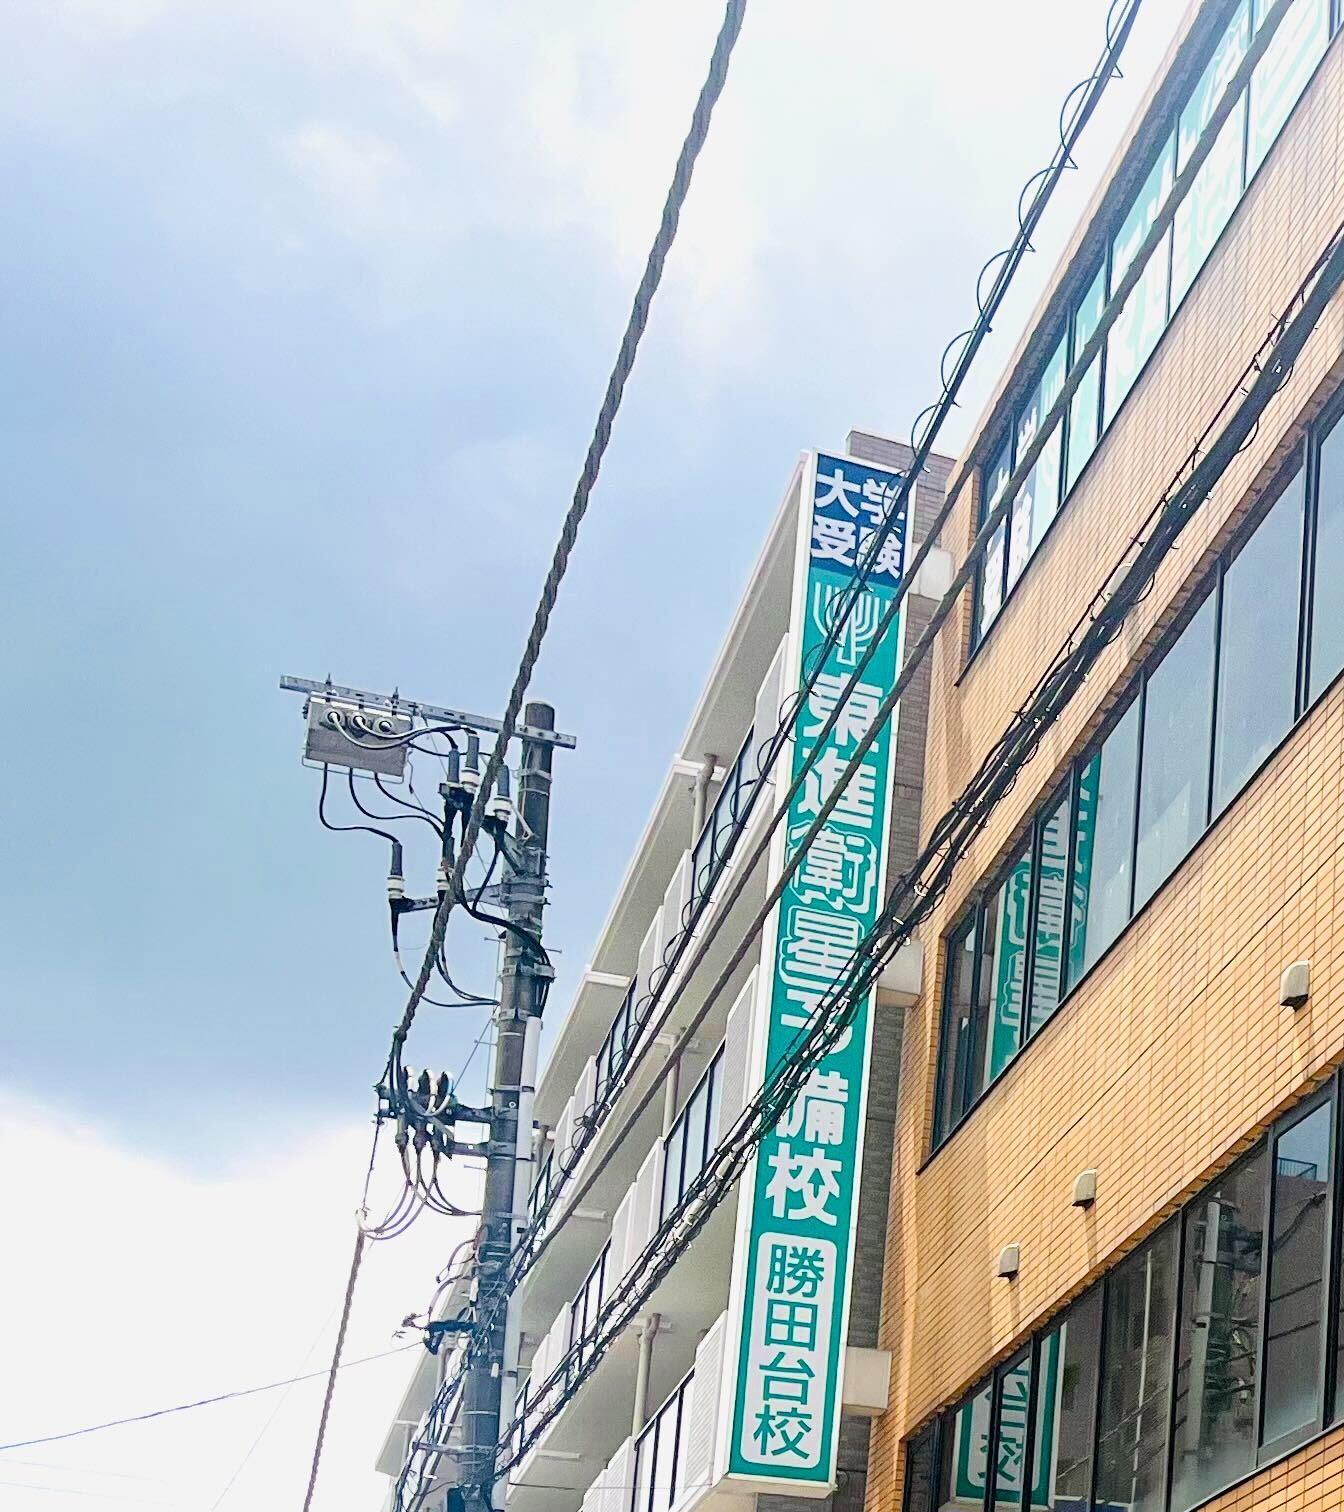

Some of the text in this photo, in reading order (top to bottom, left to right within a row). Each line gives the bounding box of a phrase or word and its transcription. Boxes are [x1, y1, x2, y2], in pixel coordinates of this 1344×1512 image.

[814, 468, 905, 526] 大学
[752, 1243, 826, 1461] 勝田台校
